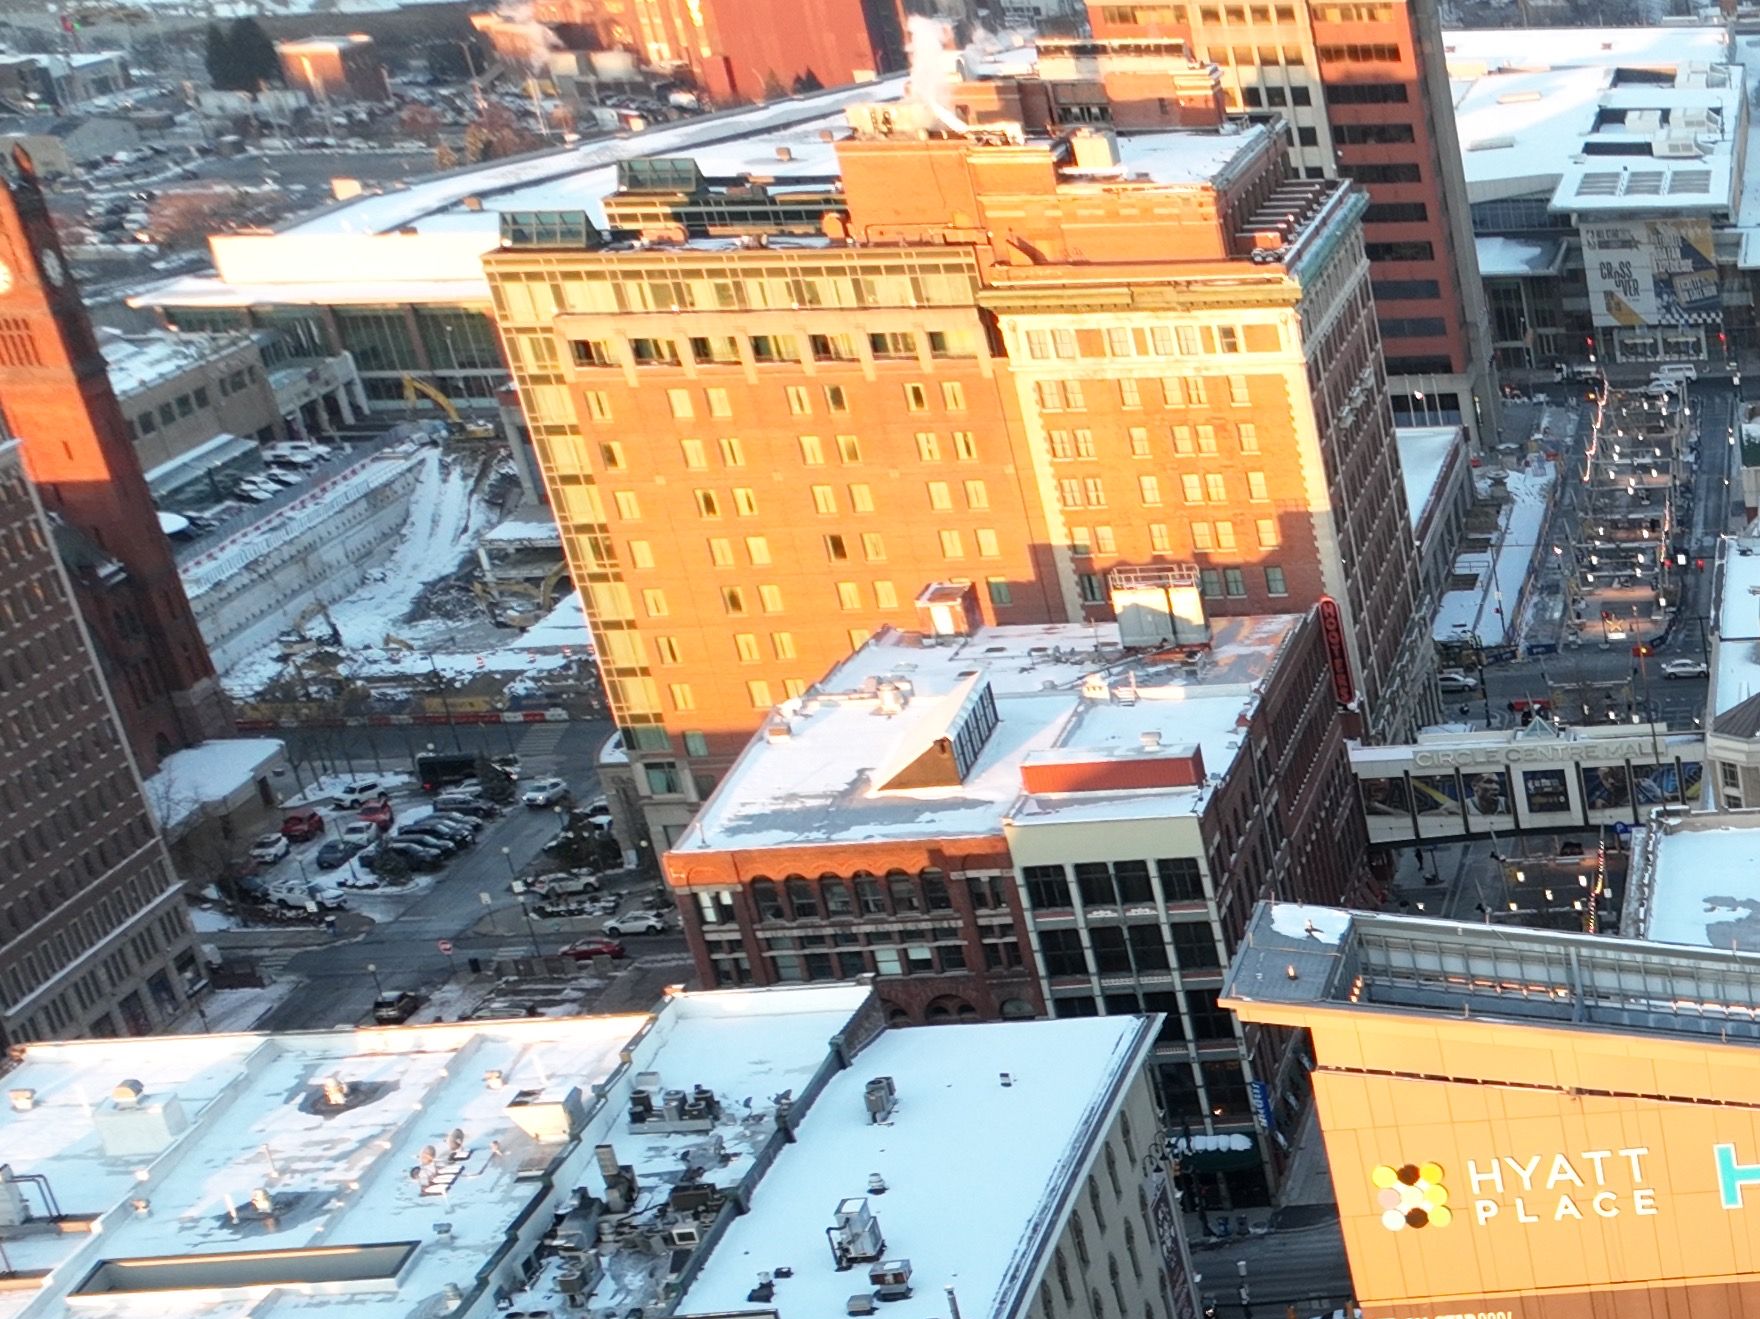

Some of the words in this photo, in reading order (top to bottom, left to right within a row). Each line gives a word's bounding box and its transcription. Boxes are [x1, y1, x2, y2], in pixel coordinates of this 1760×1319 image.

[1414, 748, 1498, 769] CIRCLE
[1504, 744, 1601, 763] CENTRE
[1605, 742, 1665, 757] MALL
[1467, 1147, 1651, 1195] HYATT
[1474, 1189, 1659, 1226] PLACE
